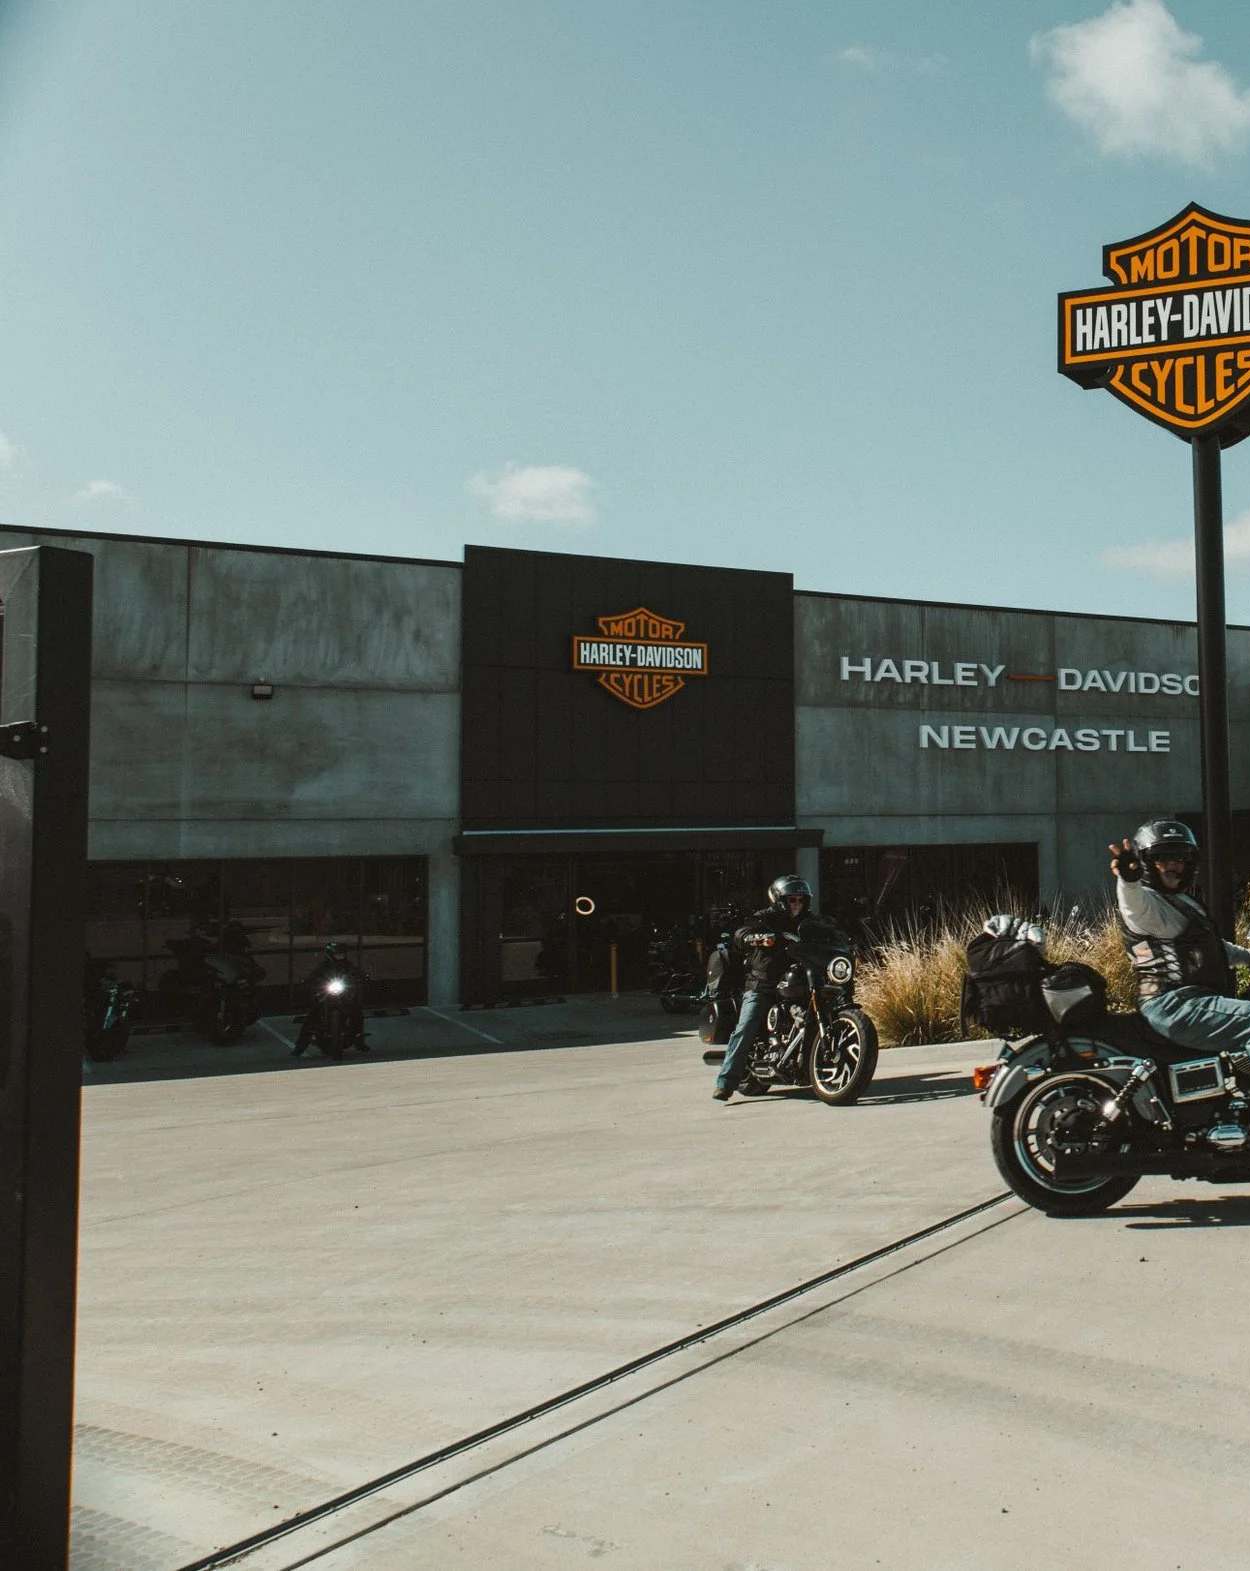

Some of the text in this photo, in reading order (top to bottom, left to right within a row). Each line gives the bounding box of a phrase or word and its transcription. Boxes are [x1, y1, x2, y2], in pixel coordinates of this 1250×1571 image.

[610, 614, 674, 640] MOTOR
[580, 642, 702, 670] HARLEY-DAVIDSON
[609, 672, 674, 703] CYCLES
[840, 656, 1006, 688] HARLEY
[1057, 668, 1200, 696] DAVIDSO
[919, 724, 1171, 753] NEWCASTLE
